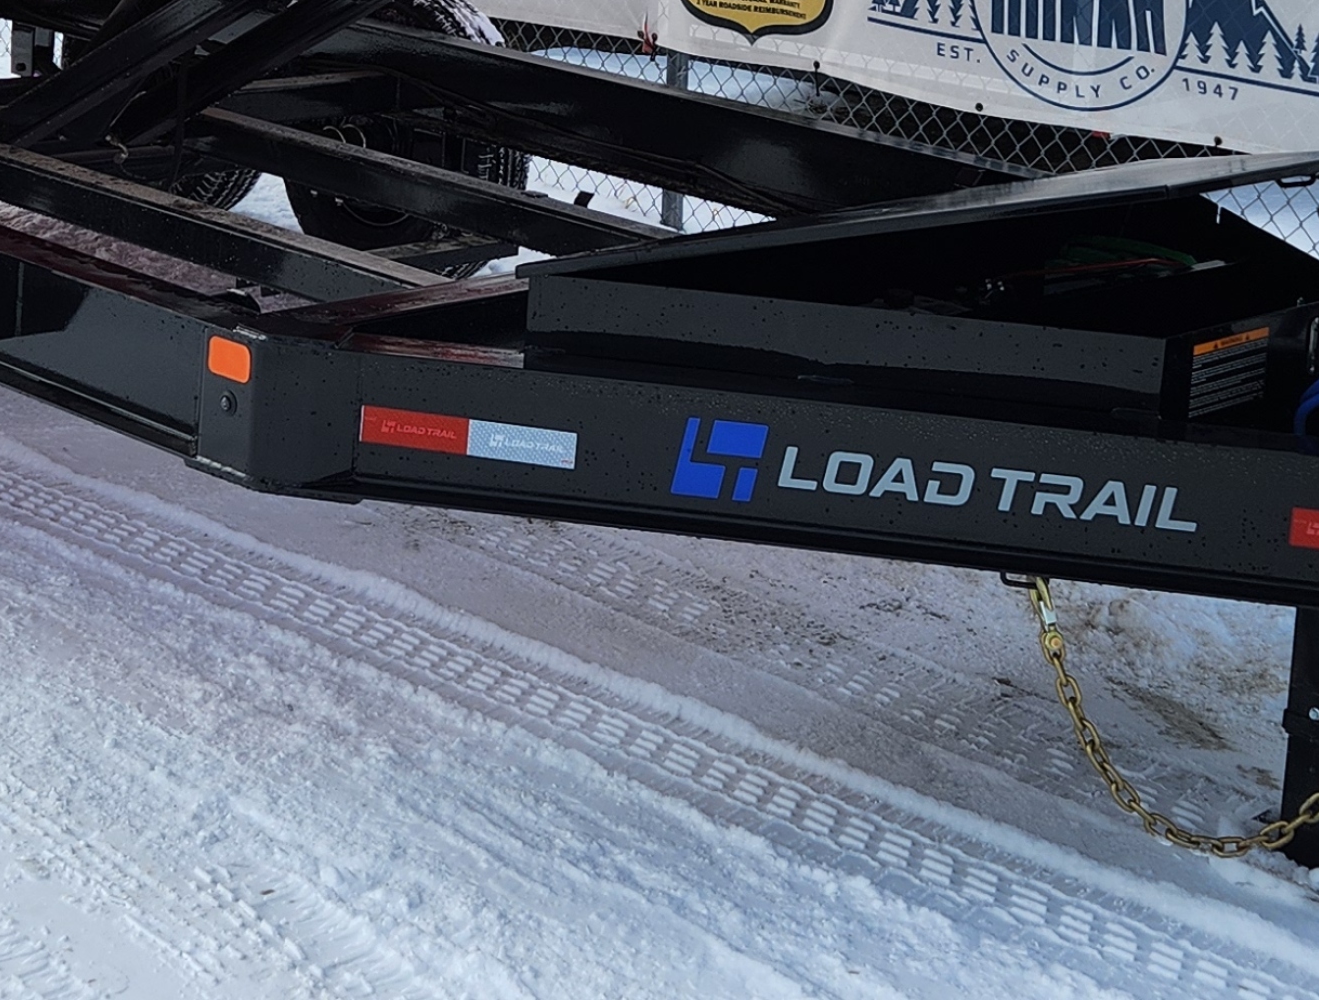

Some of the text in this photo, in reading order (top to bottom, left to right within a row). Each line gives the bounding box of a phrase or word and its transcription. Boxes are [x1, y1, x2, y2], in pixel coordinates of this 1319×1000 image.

[702, 0, 718, 8] YEAR
[719, 1, 752, 12] ROADSIDE
[753, 5, 806, 20] REIMBURSEMENT
[937, 42, 981, 63] EST.
[1006, 49, 1155, 98] SUPPLY CO.
[1182, 78, 1238, 100] 1947
[396, 423, 457, 440] LOAD TRAIL
[778, 446, 1198, 533] LOAD TRAIL
